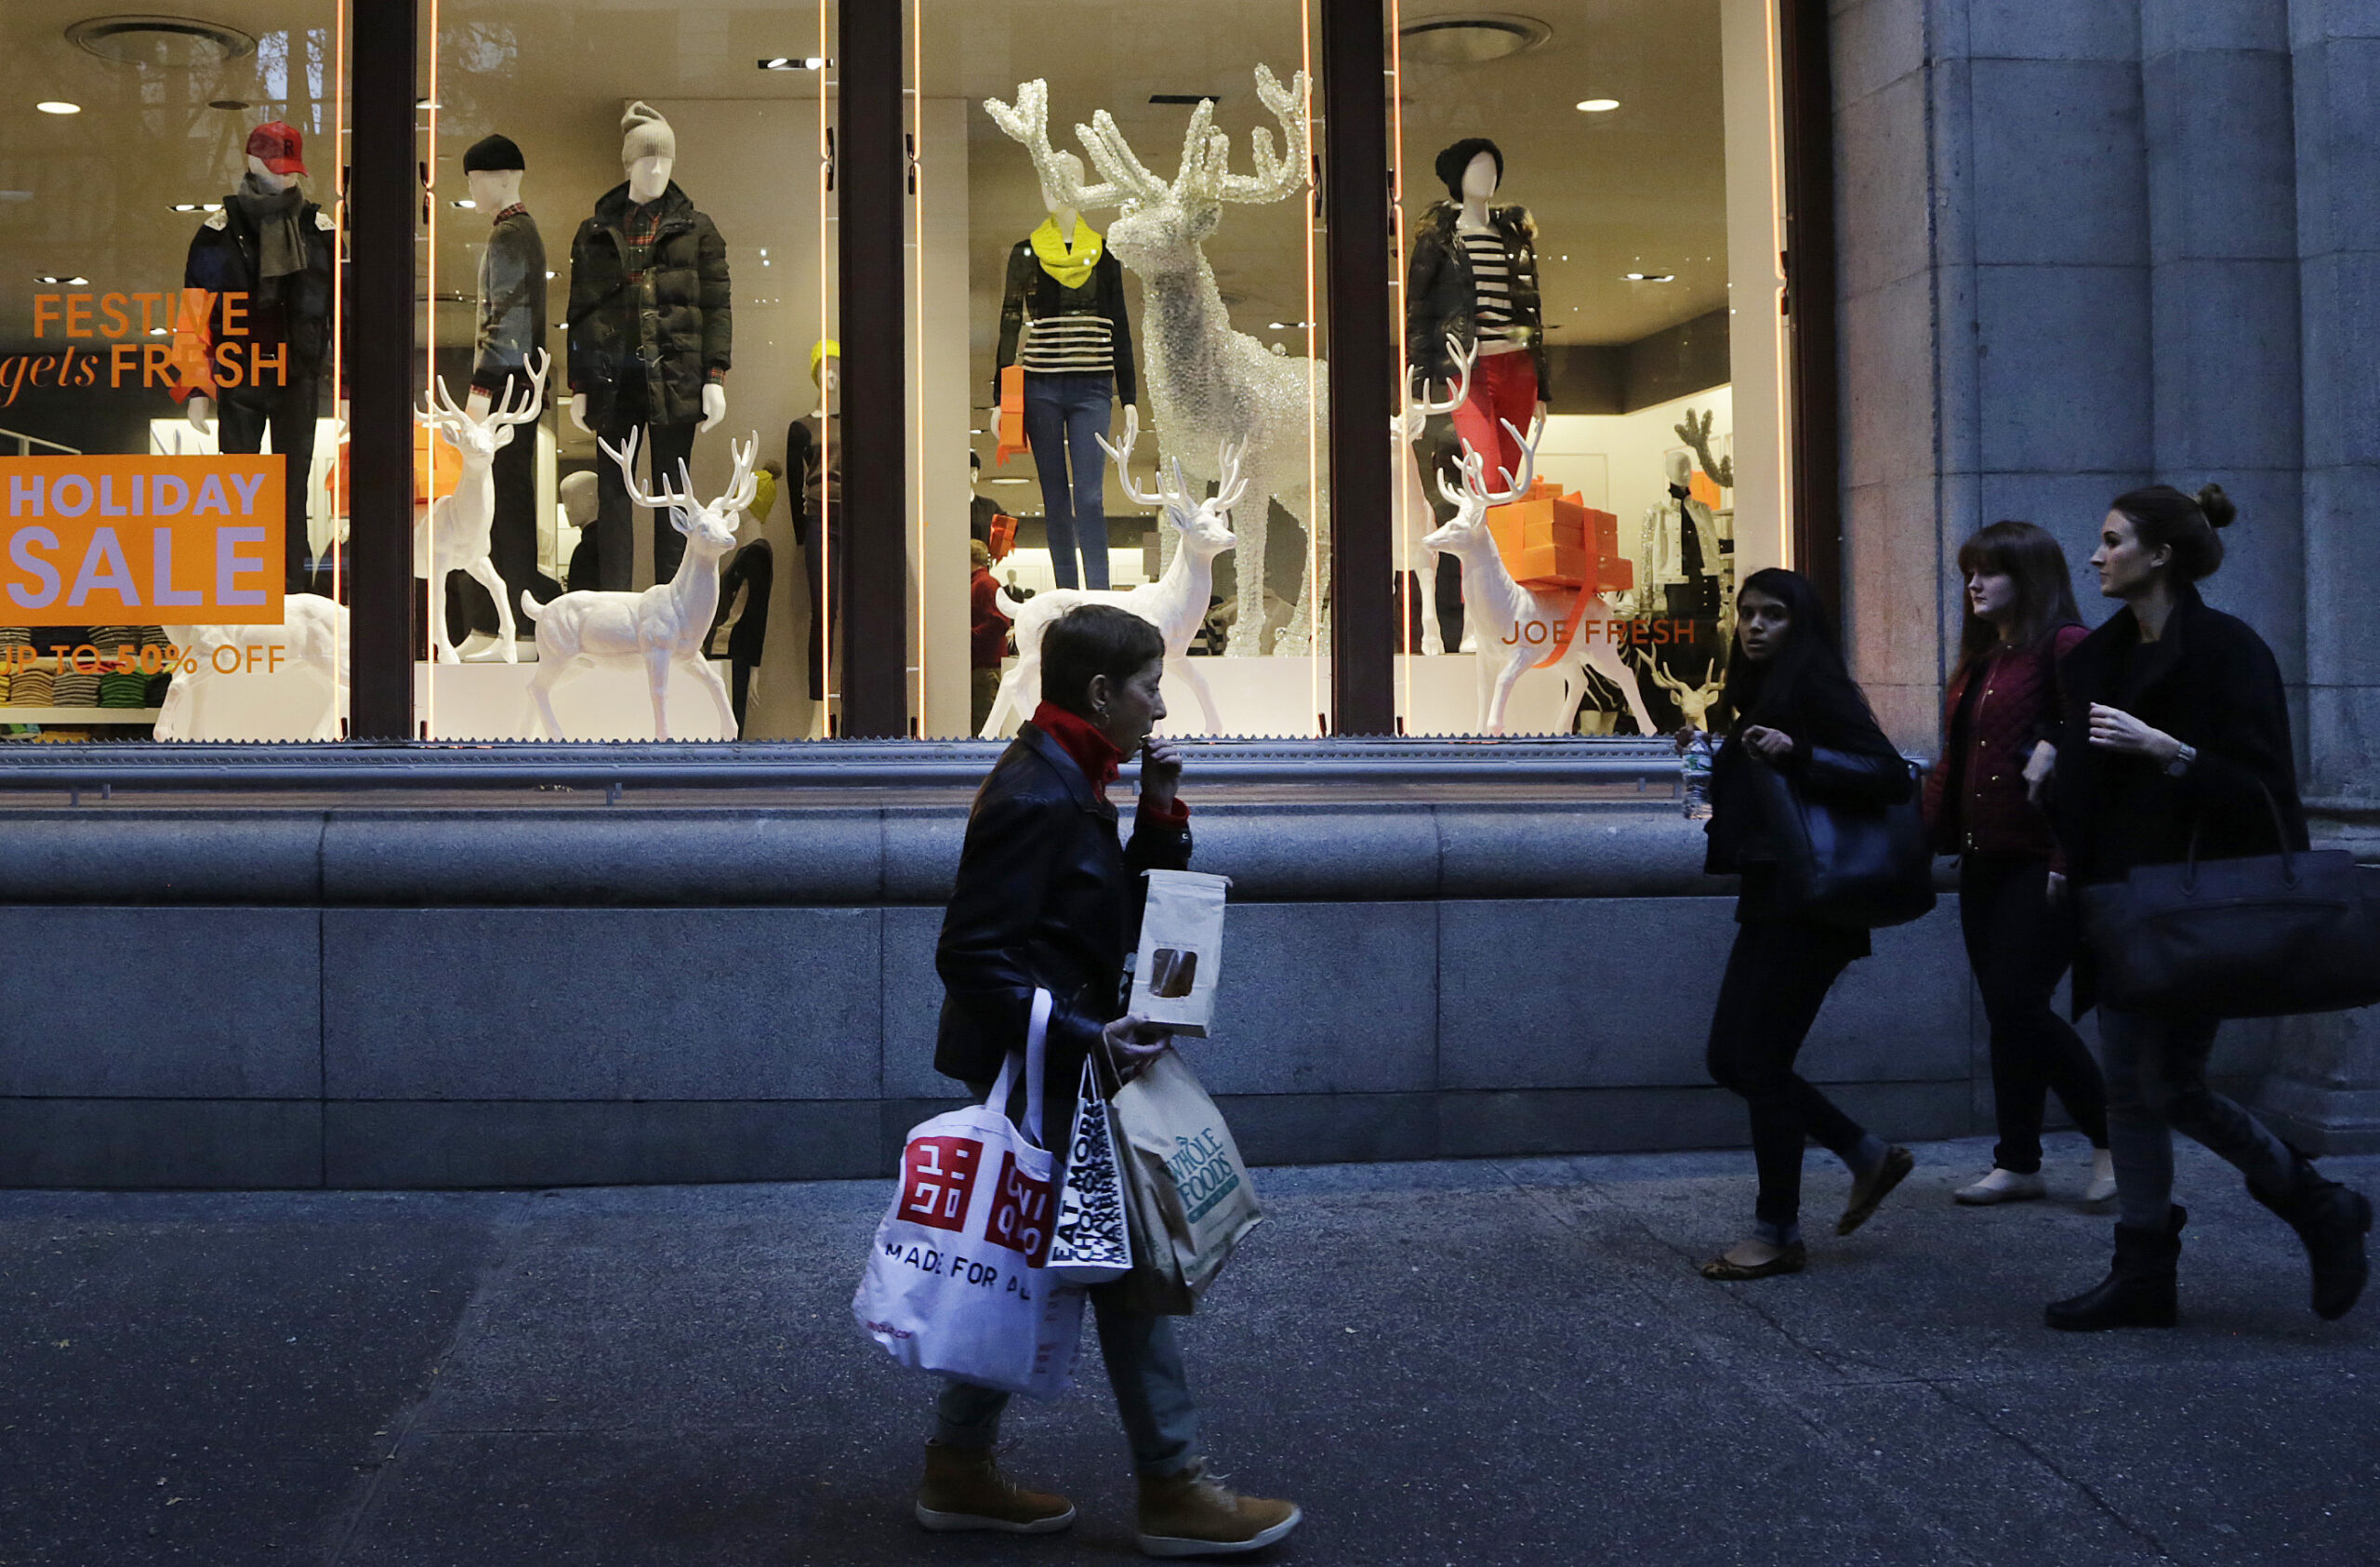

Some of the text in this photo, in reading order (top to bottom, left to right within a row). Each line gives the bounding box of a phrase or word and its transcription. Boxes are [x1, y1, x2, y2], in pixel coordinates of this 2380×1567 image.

[284, 139, 294, 155] R
[33, 292, 249, 338] FESTIVE
[111, 342, 287, 388] FRESH
[9, 473, 266, 517] HOLIDAY
[6, 525, 267, 609] SALE
[1501, 619, 1695, 645] JOE FRESH
[49, 644, 101, 675] TO
[116, 644, 198, 675] 50%
[211, 645, 284, 674] OFF
[1167, 1128, 1223, 1184] WHOLE
[1176, 1151, 1233, 1210] FOODS
[1052, 1200, 1079, 1262] EAT
[950, 1256, 998, 1287] FOR
